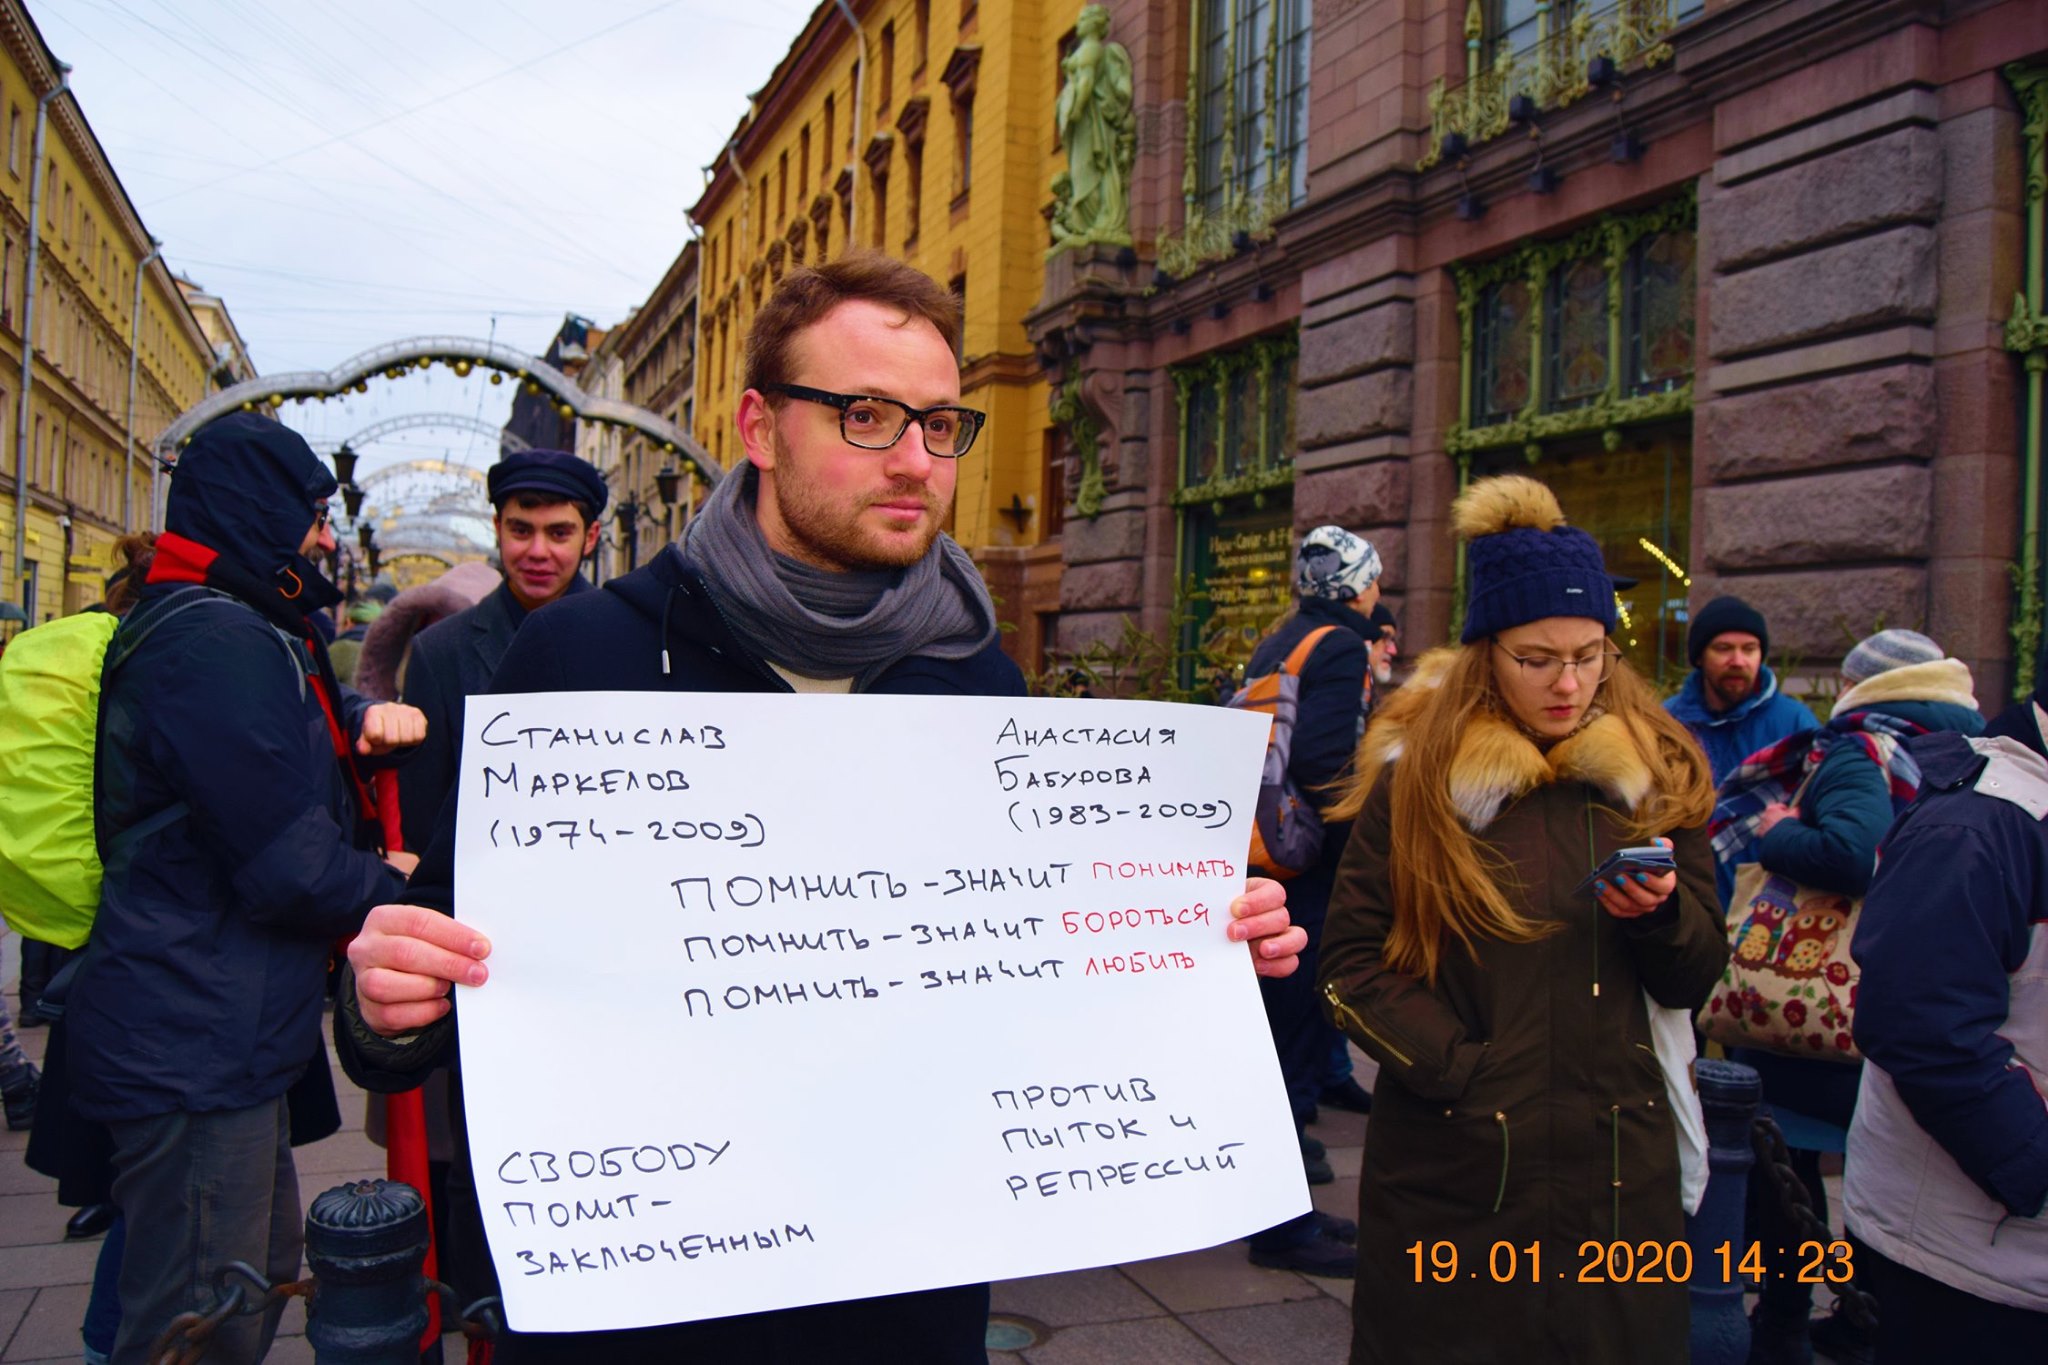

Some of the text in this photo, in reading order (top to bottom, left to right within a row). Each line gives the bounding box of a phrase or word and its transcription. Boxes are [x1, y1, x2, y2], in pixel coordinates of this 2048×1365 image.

[480, 711, 726, 749] СТАНИСЛАВ
[996, 717, 1176, 747] АНАСТАСИЯ
[483, 761, 690, 798] МАРКЕЛОВ
[994, 754, 1152, 791] БАБУРОВА
[1008, 799, 1233, 832] (1983-2009)
[671, 870, 907, 912] ПОМНИТЬ
[1093, 859, 1235, 880] ПОНИМАТЬ
[683, 928, 870, 962] ПОМНИТЬ
[1062, 903, 1210, 935] БОРОТЬСЯ
[684, 976, 880, 1017] ПОМНИТЬ
[1085, 951, 1195, 977] ЛЮБИТЬ
[991, 1078, 1156, 1110] ПРОТИВ
[1002, 1118, 1147, 1153] ПЫТОК
[498, 1140, 730, 1184] СВОБОДУ
[1006, 1142, 1246, 1201] РЕПРЕССИЙ
[503, 1193, 672, 1227] ПОЛИТ-
[516, 1223, 815, 1276] ЗАКЛЮЧЕННЫМ
